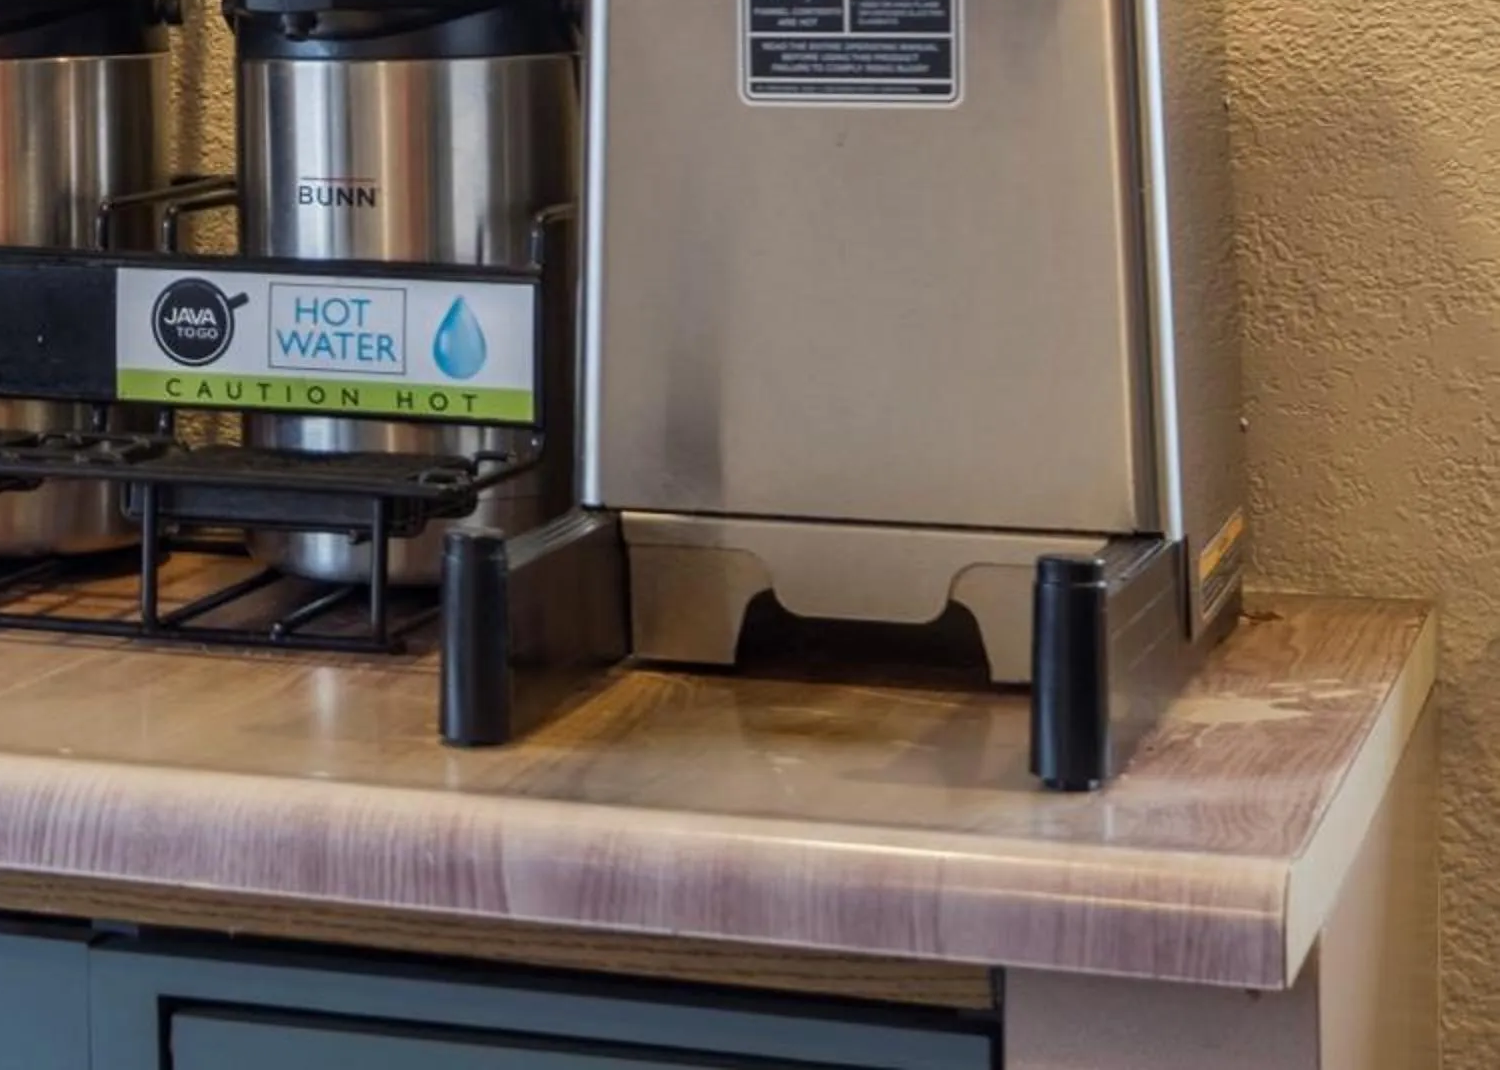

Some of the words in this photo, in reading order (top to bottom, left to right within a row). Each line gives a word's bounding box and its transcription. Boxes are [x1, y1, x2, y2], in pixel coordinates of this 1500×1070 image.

[298, 184, 377, 207] BUNN
[163, 307, 217, 325] JAVA
[294, 296, 372, 328] HOT
[276, 329, 398, 363] WATER
[165, 377, 360, 407] CAUTION
[396, 391, 480, 413] HOT
